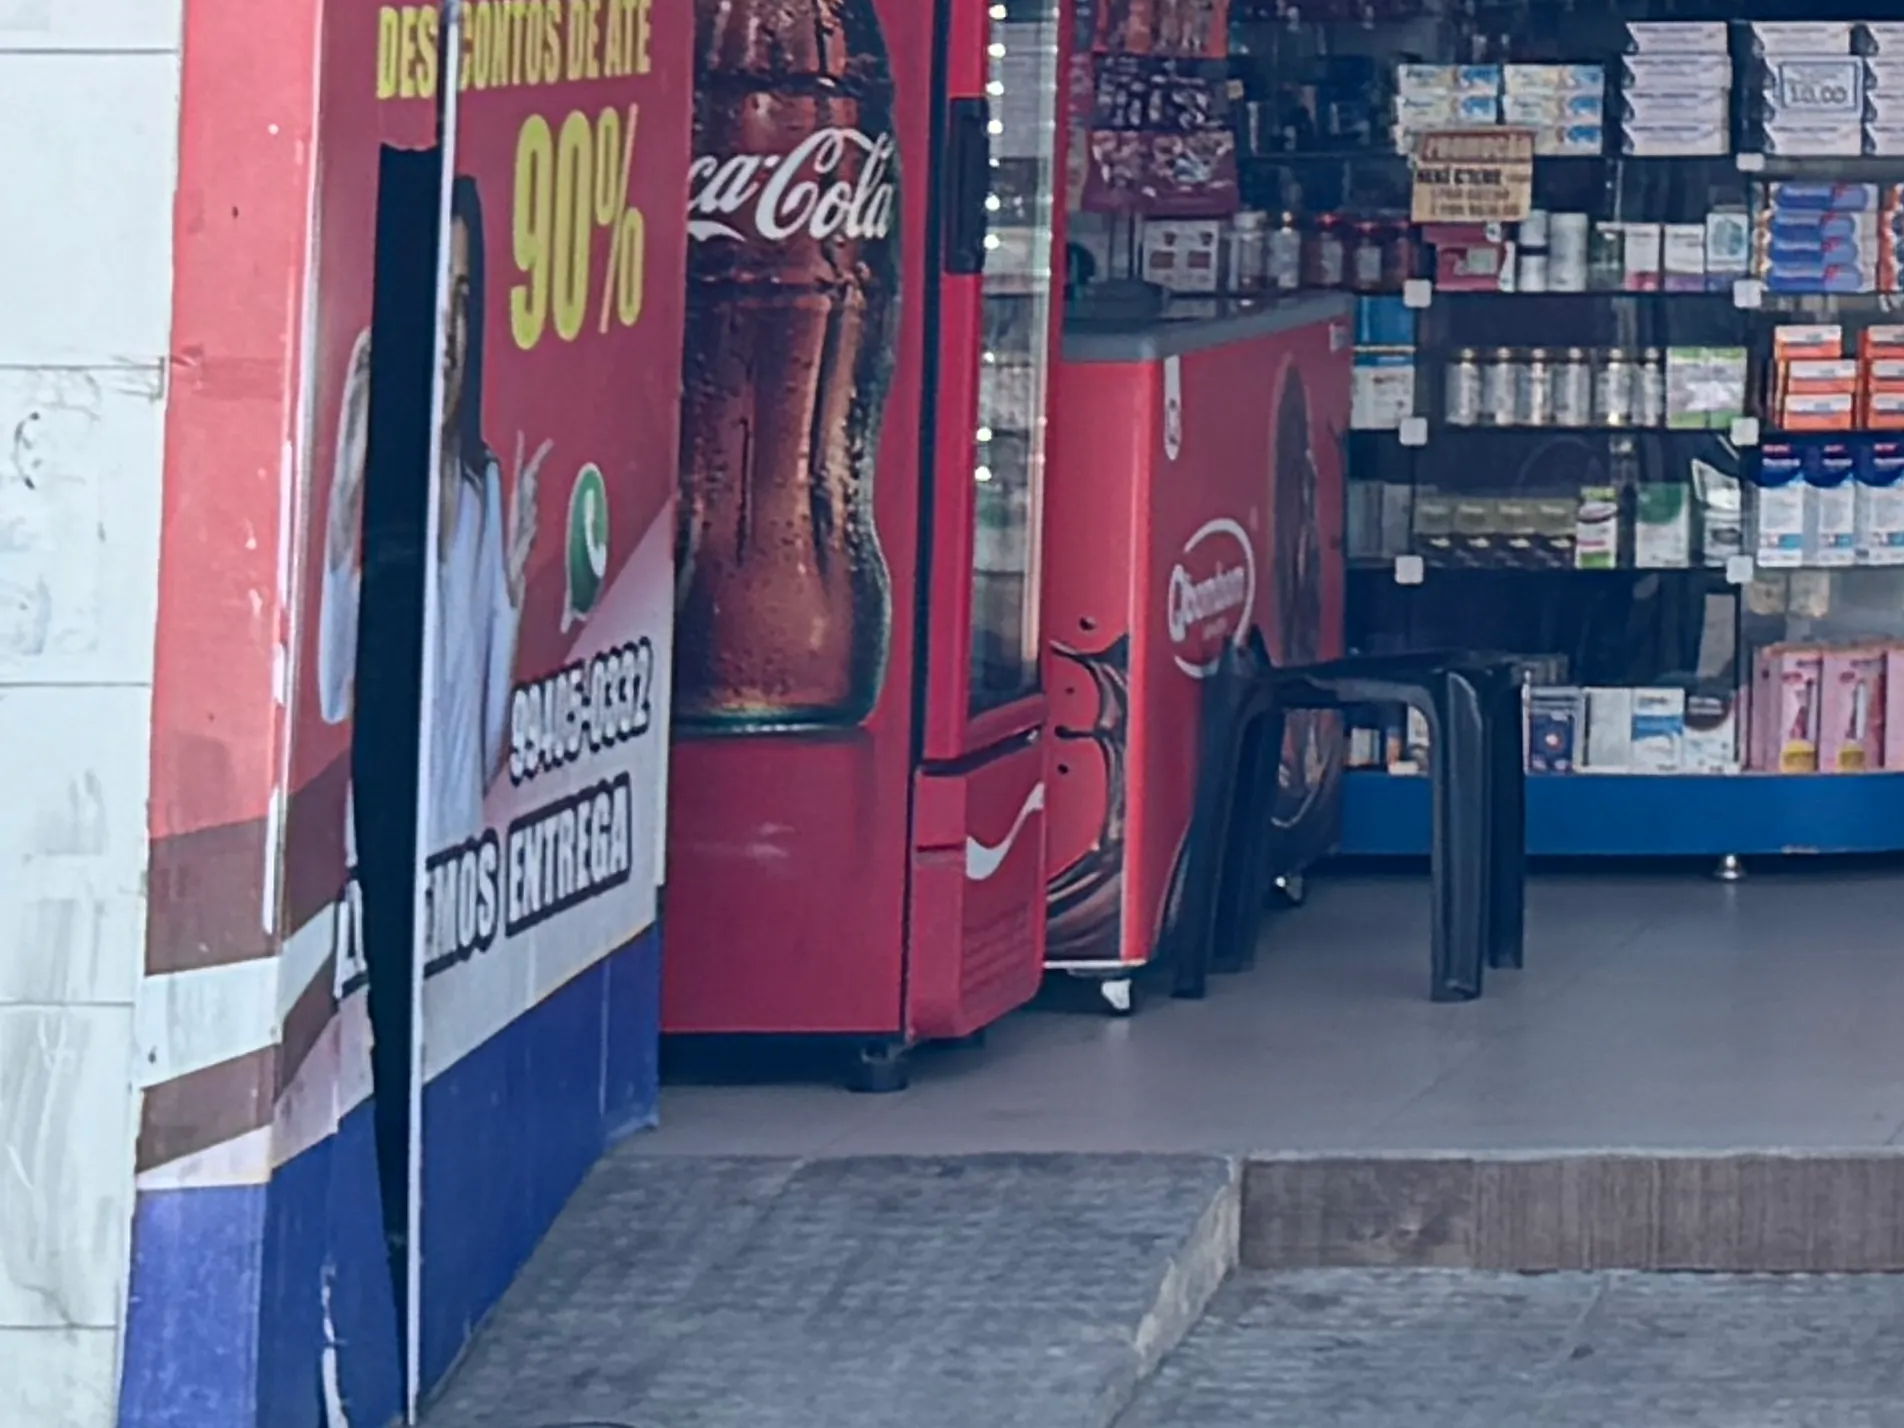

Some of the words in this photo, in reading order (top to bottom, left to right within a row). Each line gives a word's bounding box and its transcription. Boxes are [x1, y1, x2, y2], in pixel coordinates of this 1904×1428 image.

[510, 101, 645, 350] 90%
[686, 126, 896, 241] ca-Cola
[505, 770, 633, 938] ENTREGA
